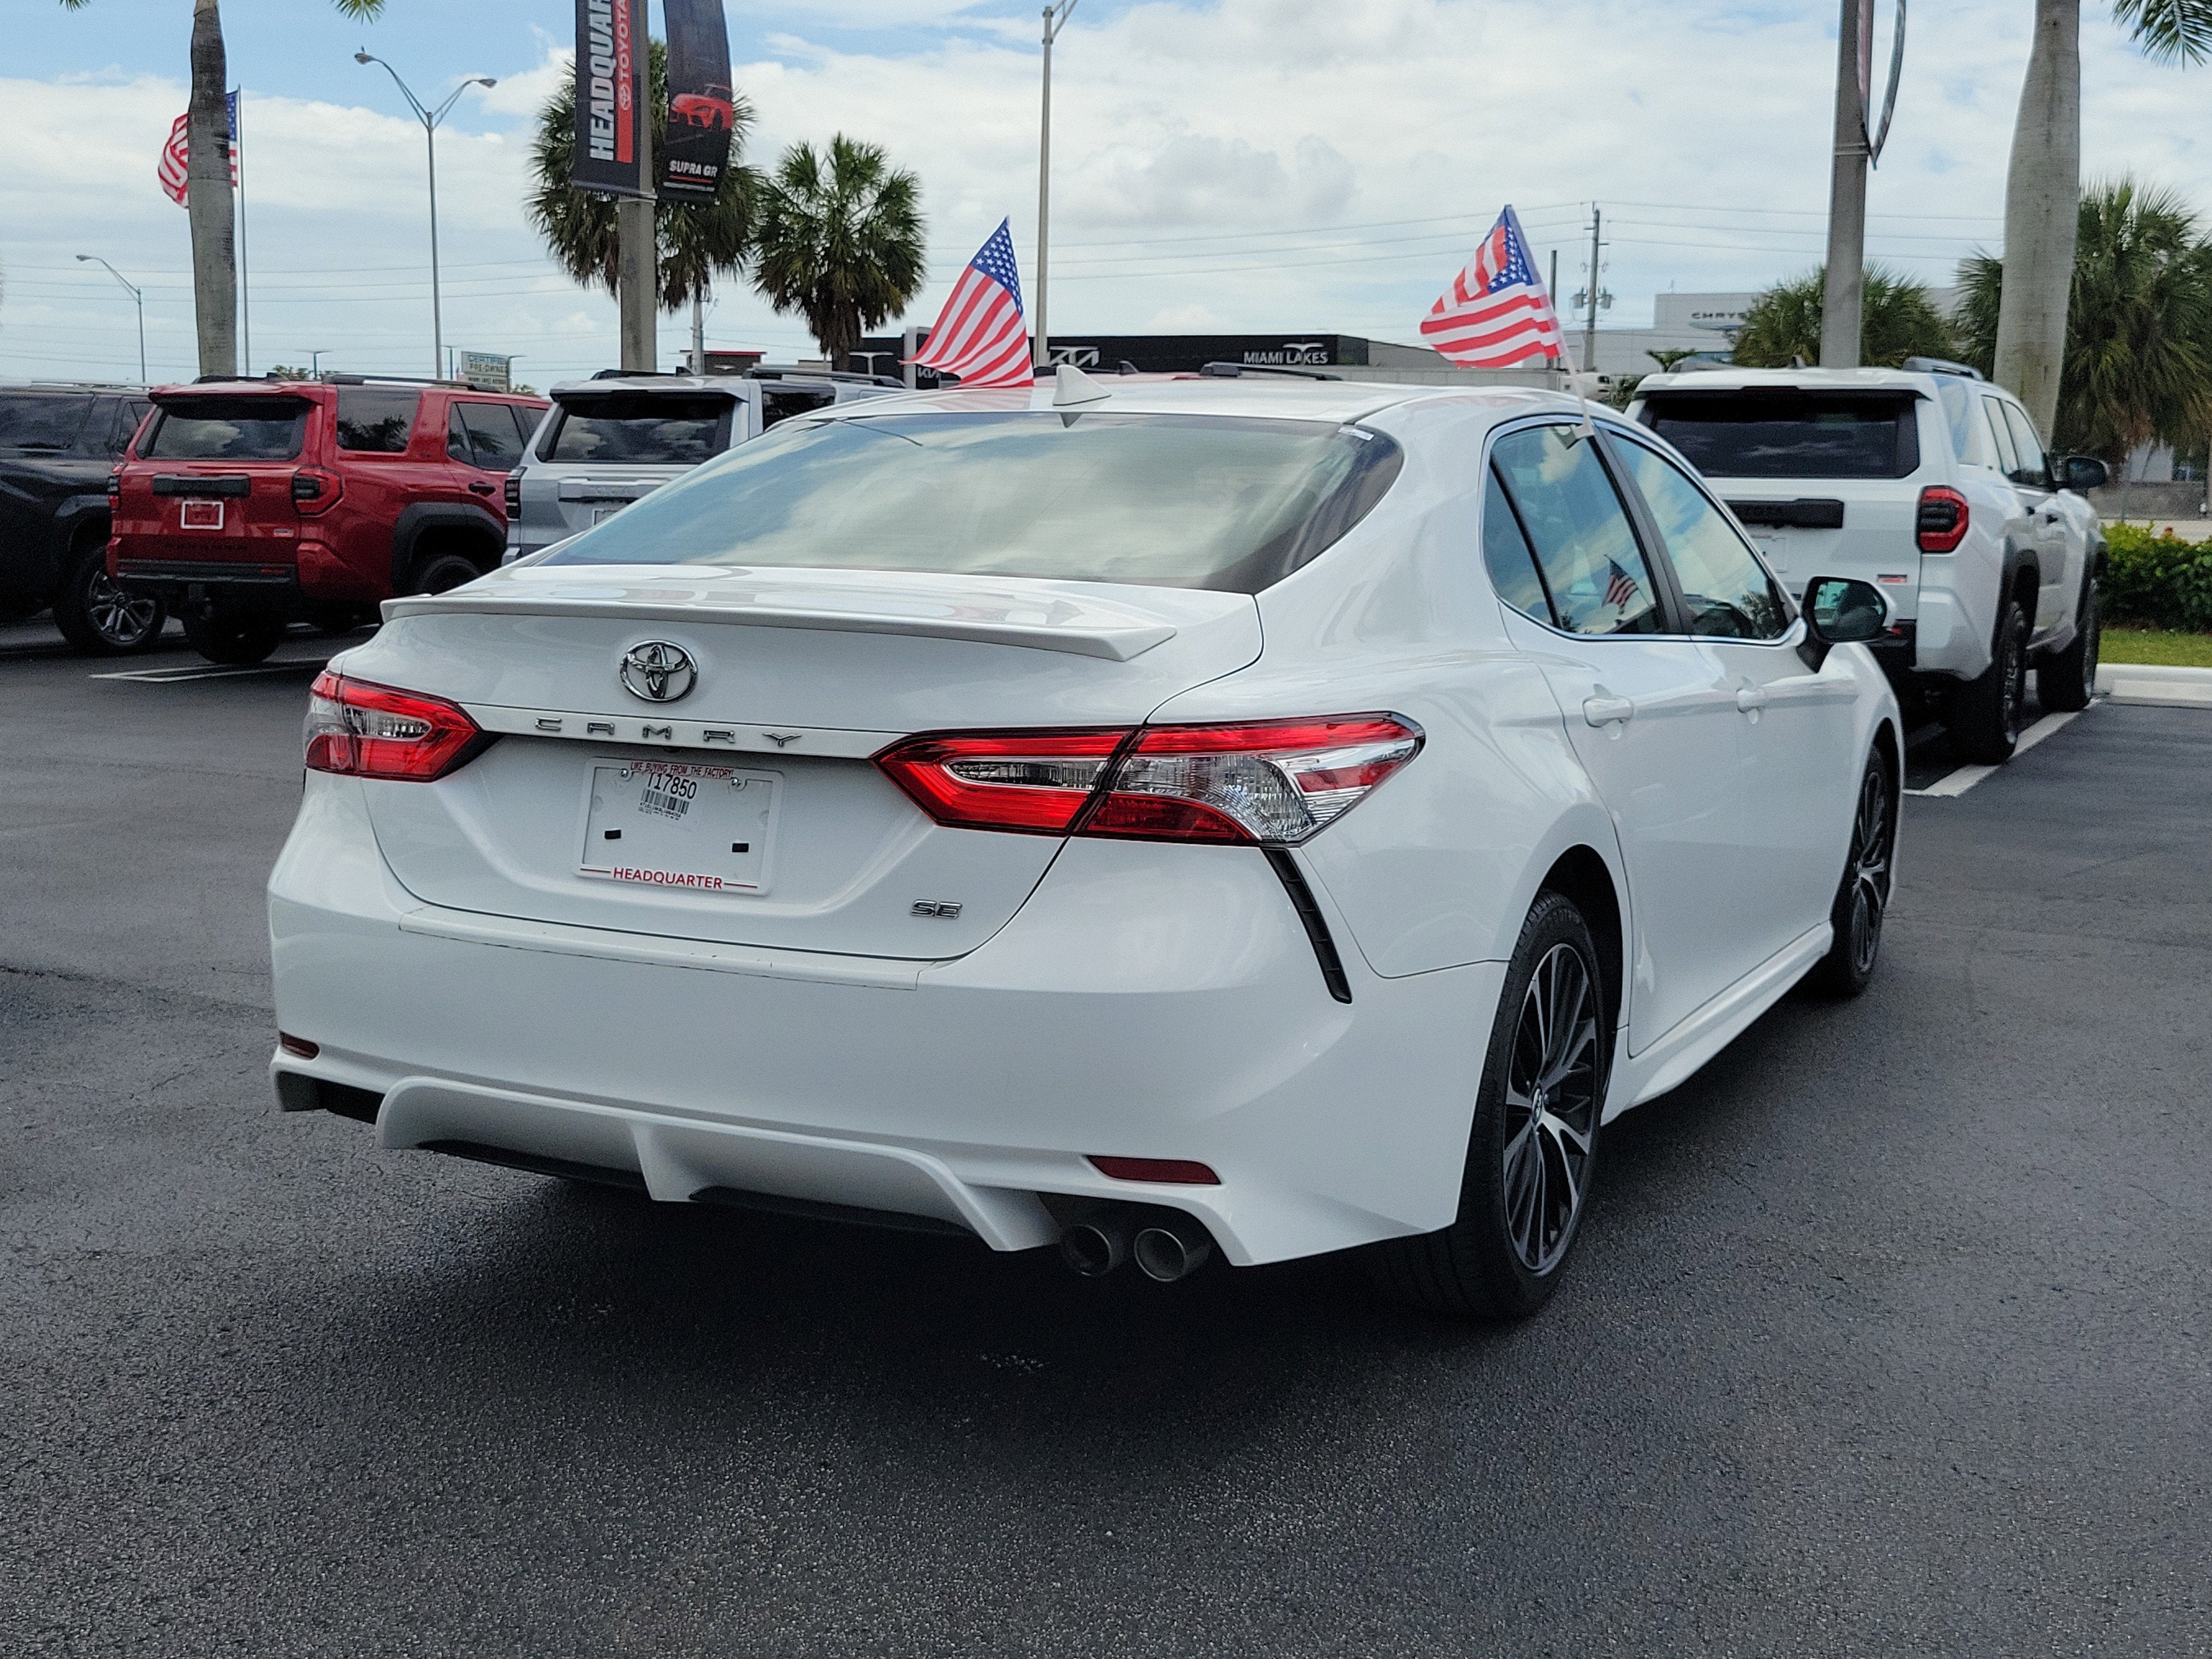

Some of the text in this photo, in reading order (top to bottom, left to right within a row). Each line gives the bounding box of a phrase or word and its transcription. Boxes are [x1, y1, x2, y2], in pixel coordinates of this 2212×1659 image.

[618, 0, 629, 82] TOYOTA
[669, 160, 718, 177] SUPRA GR
[1244, 351, 1329, 364] MIAMI LAKES
[535, 717, 802, 747] CAMRY
[631, 761, 643, 770] LIKE
[646, 763, 668, 774] BUYING
[670, 765, 688, 775] FROM
[691, 766, 702, 776] THE
[613, 867, 723, 889] HEADQUARTER
[911, 899, 963, 919] SE
